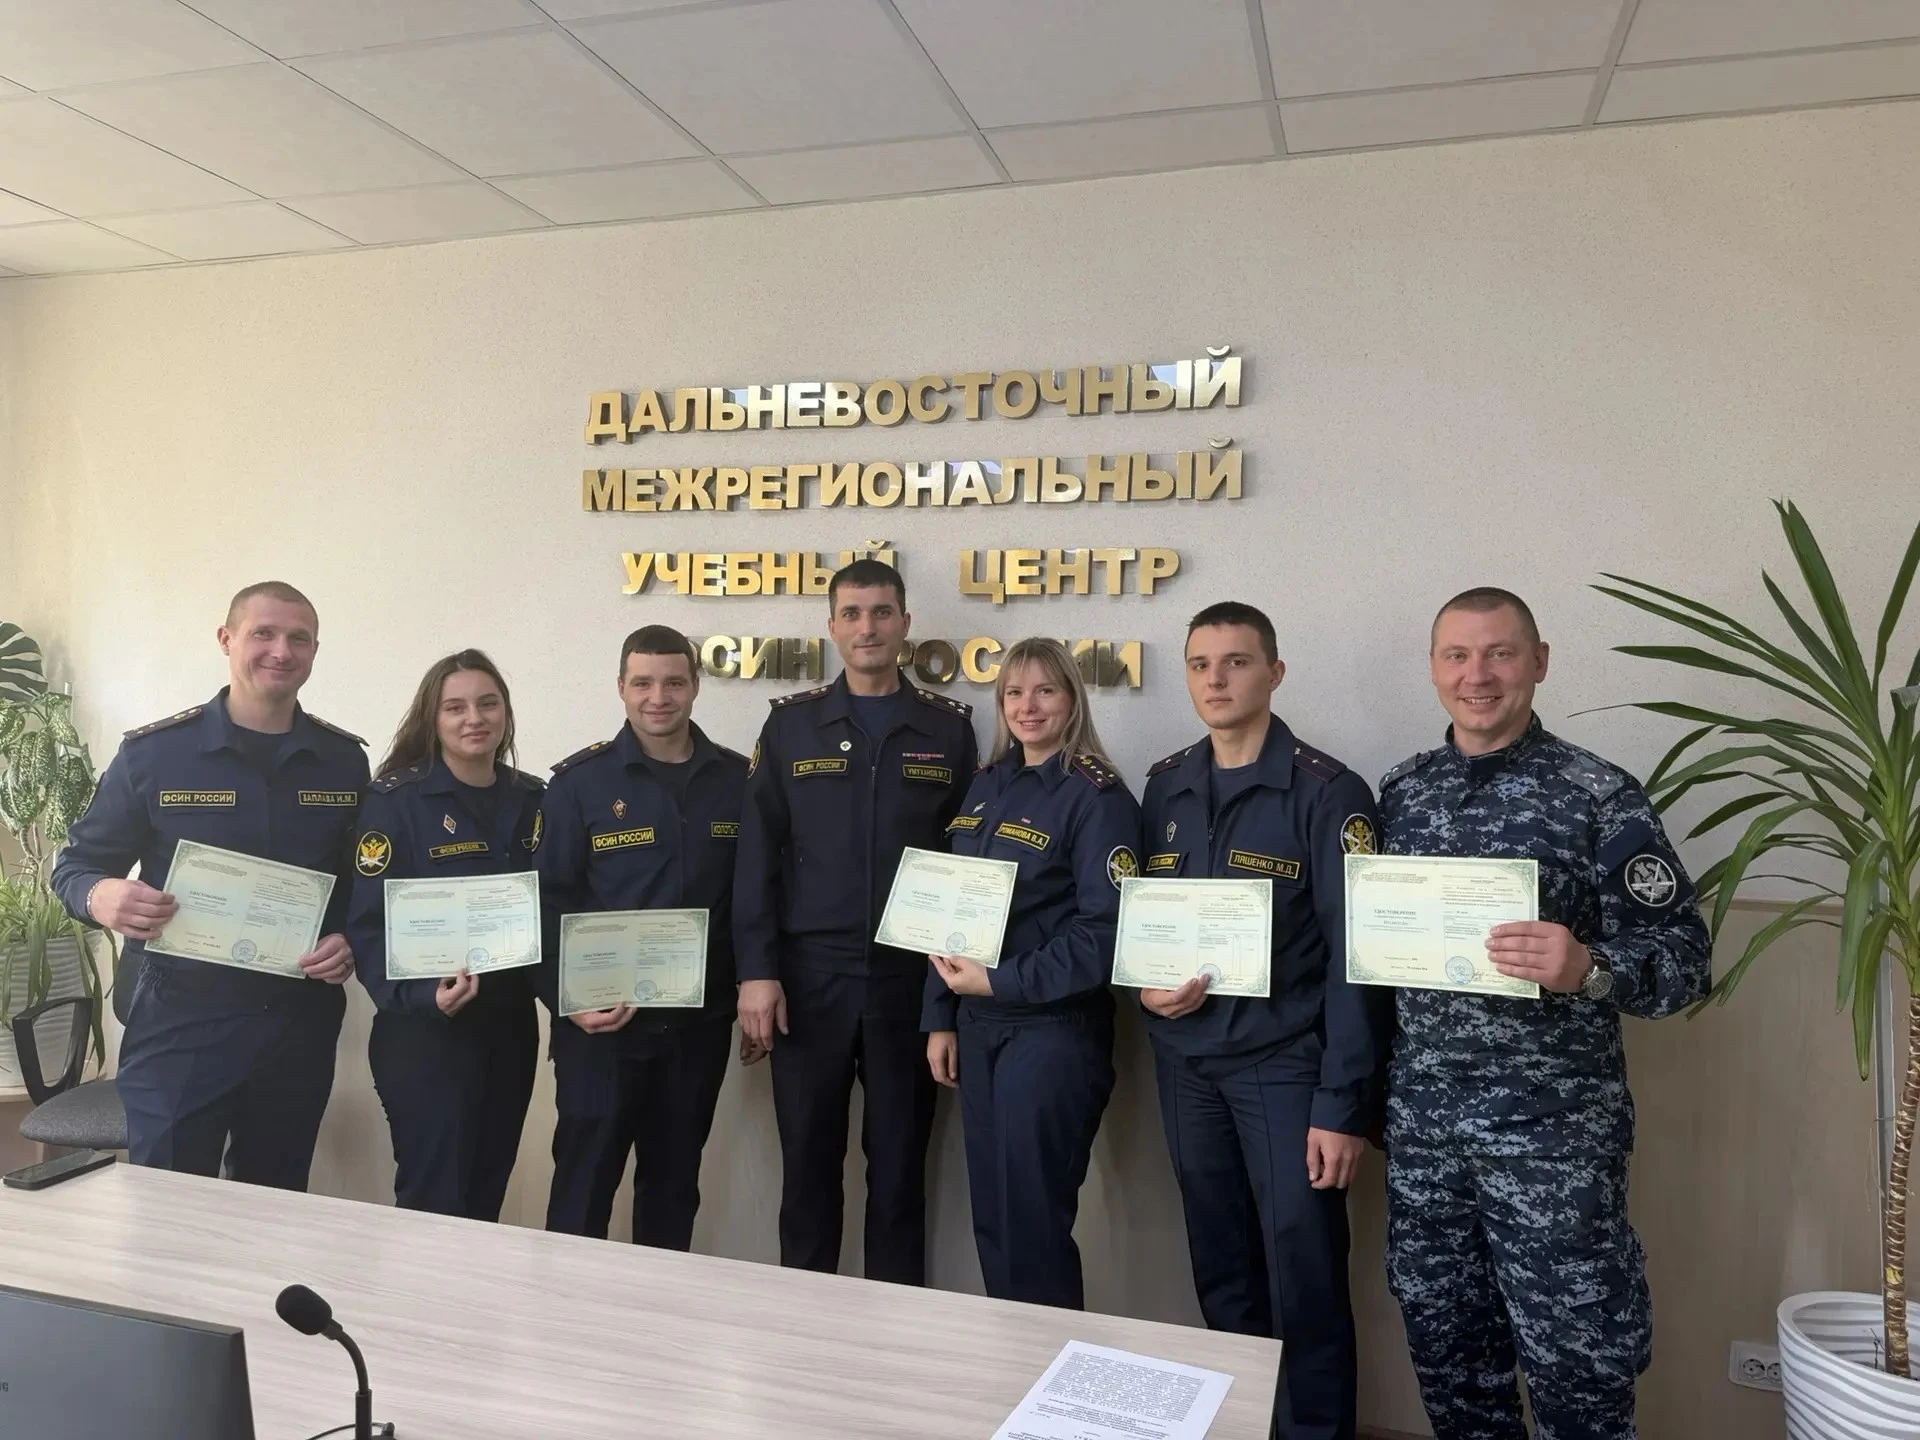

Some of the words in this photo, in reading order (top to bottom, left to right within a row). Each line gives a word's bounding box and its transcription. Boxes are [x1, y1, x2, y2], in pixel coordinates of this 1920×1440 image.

[584, 345, 1242, 445] ДАЛЬНЕВОСТОЧНЫЙ
[582, 437, 1243, 512] МЕЖРЕГИОНАЛЬНЫЙ
[959, 548, 1180, 604] ЦЕНТР
[689, 634, 825, 681] СИН
[163, 793, 191, 803] ФСИН
[194, 794, 233, 802] РОССИИ
[595, 835, 618, 848] ФСИН
[619, 830, 653, 844] РОССИИ
[1001, 826, 1031, 840] РОМАНОВА
[1031, 833, 1044, 846] В.А.
[1234, 854, 1274, 870] ЛЯШЕНКО
[1275, 862, 1295, 876] М.Д.
